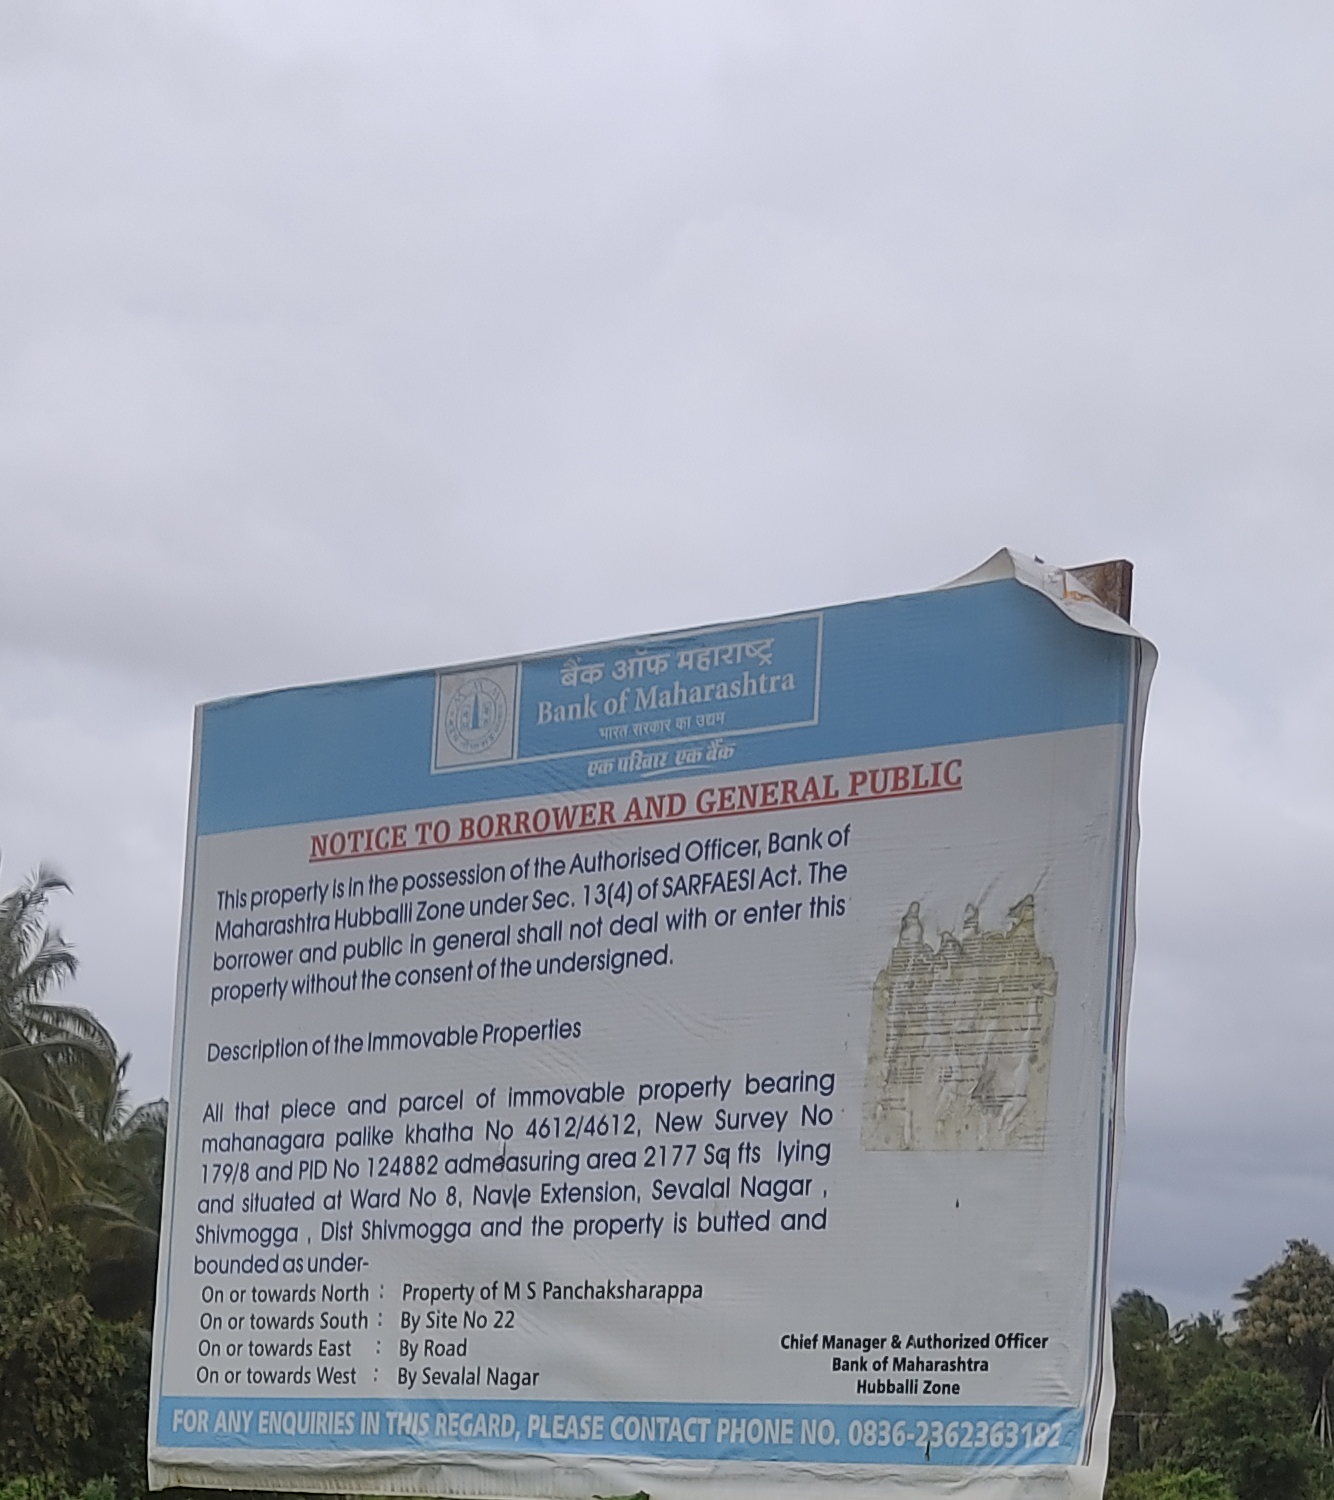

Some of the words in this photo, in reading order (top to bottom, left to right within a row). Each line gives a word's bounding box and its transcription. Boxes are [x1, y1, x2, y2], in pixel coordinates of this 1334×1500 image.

[612, 648, 670, 681] ऑफ
[678, 638, 775, 672] महाराष्ट्र
[537, 689, 598, 726] Bank
[604, 684, 630, 716] of
[633, 669, 796, 712] Maharashtra
[310, 825, 407, 858] NOTICE
[415, 820, 451, 846] TO
[458, 801, 617, 842] BORROWER
[624, 793, 687, 823] AND
[696, 774, 840, 815] GENERAL
[848, 759, 963, 798] PUBLIC
[217, 889, 247, 911] This
[250, 880, 329, 912] property
[332, 878, 344, 899] is
[348, 876, 364, 898] in
[369, 874, 398, 895] the
[402, 863, 505, 896] possession
[510, 858, 530, 880] of
[534, 857, 566, 878] the
[569, 842, 681, 875] Authorised
[685, 837, 761, 862] Officer,
[768, 827, 823, 854] Bank
[827, 823, 851, 848] of
[215, 912, 330, 942] Maharashtra
[334, 901, 413, 930] Hubballi
[416, 900, 465, 922] Zone
[470, 892, 529, 917] under
[532, 889, 575, 911] Sec.
[584, 880, 632, 909] 13(4)
[637, 877, 659, 900] of
[662, 867, 756, 899] SARFAESI
[758, 864, 802, 890] Act.
[808, 861, 847, 884] The
[213, 949, 294, 971] borrower
[299, 941, 337, 964] and
[343, 935, 403, 965] public
[410, 933, 426, 954] in
[433, 924, 511, 957] general
[517, 920, 562, 944] shall
[570, 916, 603, 940] not
[609, 911, 658, 936] deal
[666, 907, 707, 931] with
[714, 909, 737, 927] or
[744, 899, 803, 924] enter
[809, 894, 845, 919] this
[211, 976, 288, 1007] property
[291, 970, 357, 995] without
[361, 969, 391, 990] the
[395, 960, 473, 987] consent
[477, 957, 497, 980] of
[500, 956, 532, 978] the
[536, 943, 673, 975] undersigned.
[208, 1037, 308, 1063] Description
[312, 1034, 331, 1056] of
[334, 1033, 363, 1054] the
[368, 1025, 478, 1052] Immovable
[482, 1018, 581, 1047] Properties
[202, 1102, 223, 1123] All
[235, 1100, 270, 1122] that
[281, 1098, 335, 1124] piece
[348, 1093, 387, 1115] and
[399, 1089, 463, 1118] parcel
[476, 1087, 496, 1109] of
[508, 1081, 625, 1108] immovable
[638, 1075, 732, 1106] property
[745, 1070, 835, 1096] bearing
[202, 1132, 325, 1155] mahanagara
[336, 1125, 394, 1152] palike
[405, 1122, 473, 1144] khatha
[486, 1119, 513, 1141] No
[526, 1113, 641, 1140] 4612/4612,
[655, 1111, 703, 1134] New
[715, 1108, 788, 1133] Survey
[801, 1103, 833, 1127] No
[202, 1162, 249, 1185] 179/8
[256, 1160, 293, 1182] and
[298, 1159, 328, 1180] PID
[333, 1158, 360, 1179] No
[368, 1154, 438, 1178] 124882
[445, 1150, 580, 1176] admeasuring
[587, 1151, 636, 1170] area
[644, 1144, 697, 1167] 2177
[704, 1143, 730, 1170] Sq
[738, 1141, 761, 1164] fts
[777, 1139, 831, 1167] lying
[198, 1193, 234, 1214] and
[242, 1190, 315, 1213] situated
[323, 1189, 342, 1210] at
[350, 1187, 401, 1209] Ward
[409, 1186, 436, 1208] No
[446, 1185, 462, 1208] 8,
[541, 1180, 641, 1204] Extension,
[652, 1176, 730, 1200] Sevalal
[741, 1175, 813, 1202] Nagar
[195, 1224, 298, 1248] Shivmogga
[321, 1220, 353, 1241] Dist
[361, 1219, 471, 1244] Shivmogga
[480, 1215, 522, 1237] and
[531, 1215, 564, 1236] the
[573, 1212, 664, 1241] property
[673, 1211, 687, 1234] is
[697, 1209, 770, 1233] butted
[781, 1207, 827, 1231] and
[202, 1285, 224, 1303] On
[229, 1289, 247, 1303] or
[251, 1283, 316, 1303] towards
[322, 1282, 369, 1302] North
[403, 1283, 475, 1306] Property
[480, 1280, 499, 1300] of
[504, 1281, 520, 1300] M
[527, 1281, 536, 1300] S
[543, 1279, 703, 1304] Panchaksharappa
[200, 1312, 222, 1330] On
[228, 1316, 245, 1330] or
[250, 1310, 314, 1330] towards
[320, 1310, 368, 1330] South
[401, 1311, 421, 1334] By
[426, 1309, 457, 1329] Site
[463, 1310, 487, 1329] No
[493, 1310, 515, 1329] 22
[781, 1333, 819, 1350] Chief
[822, 1335, 887, 1353] Manager
[891, 1334, 902, 1349] &
[905, 1332, 990, 1349] Authorized
[995, 1332, 1049, 1349] Officer
[832, 1355, 868, 1372] Bank
[872, 1355, 889, 1372] of
[892, 1356, 989, 1372] Maharashtra
[857, 1378, 919, 1394] Hubballi
[923, 1380, 960, 1395] Zone
[173, 1409, 208, 1433] FOR
[212, 1409, 254, 1433] ANY
[258, 1410, 355, 1436] ENQUIRIES
[360, 1411, 380, 1435] IN
[385, 1411, 429, 1438] THIS
[434, 1412, 521, 1443] REGARD,
[527, 1414, 604, 1441] PLEASE
[610, 1415, 711, 1443] CONTACT
[717, 1418, 794, 1444] PHONE
[800, 1419, 841, 1445] NO.
[848, 1419, 1062, 1449] 0836-2362363182
